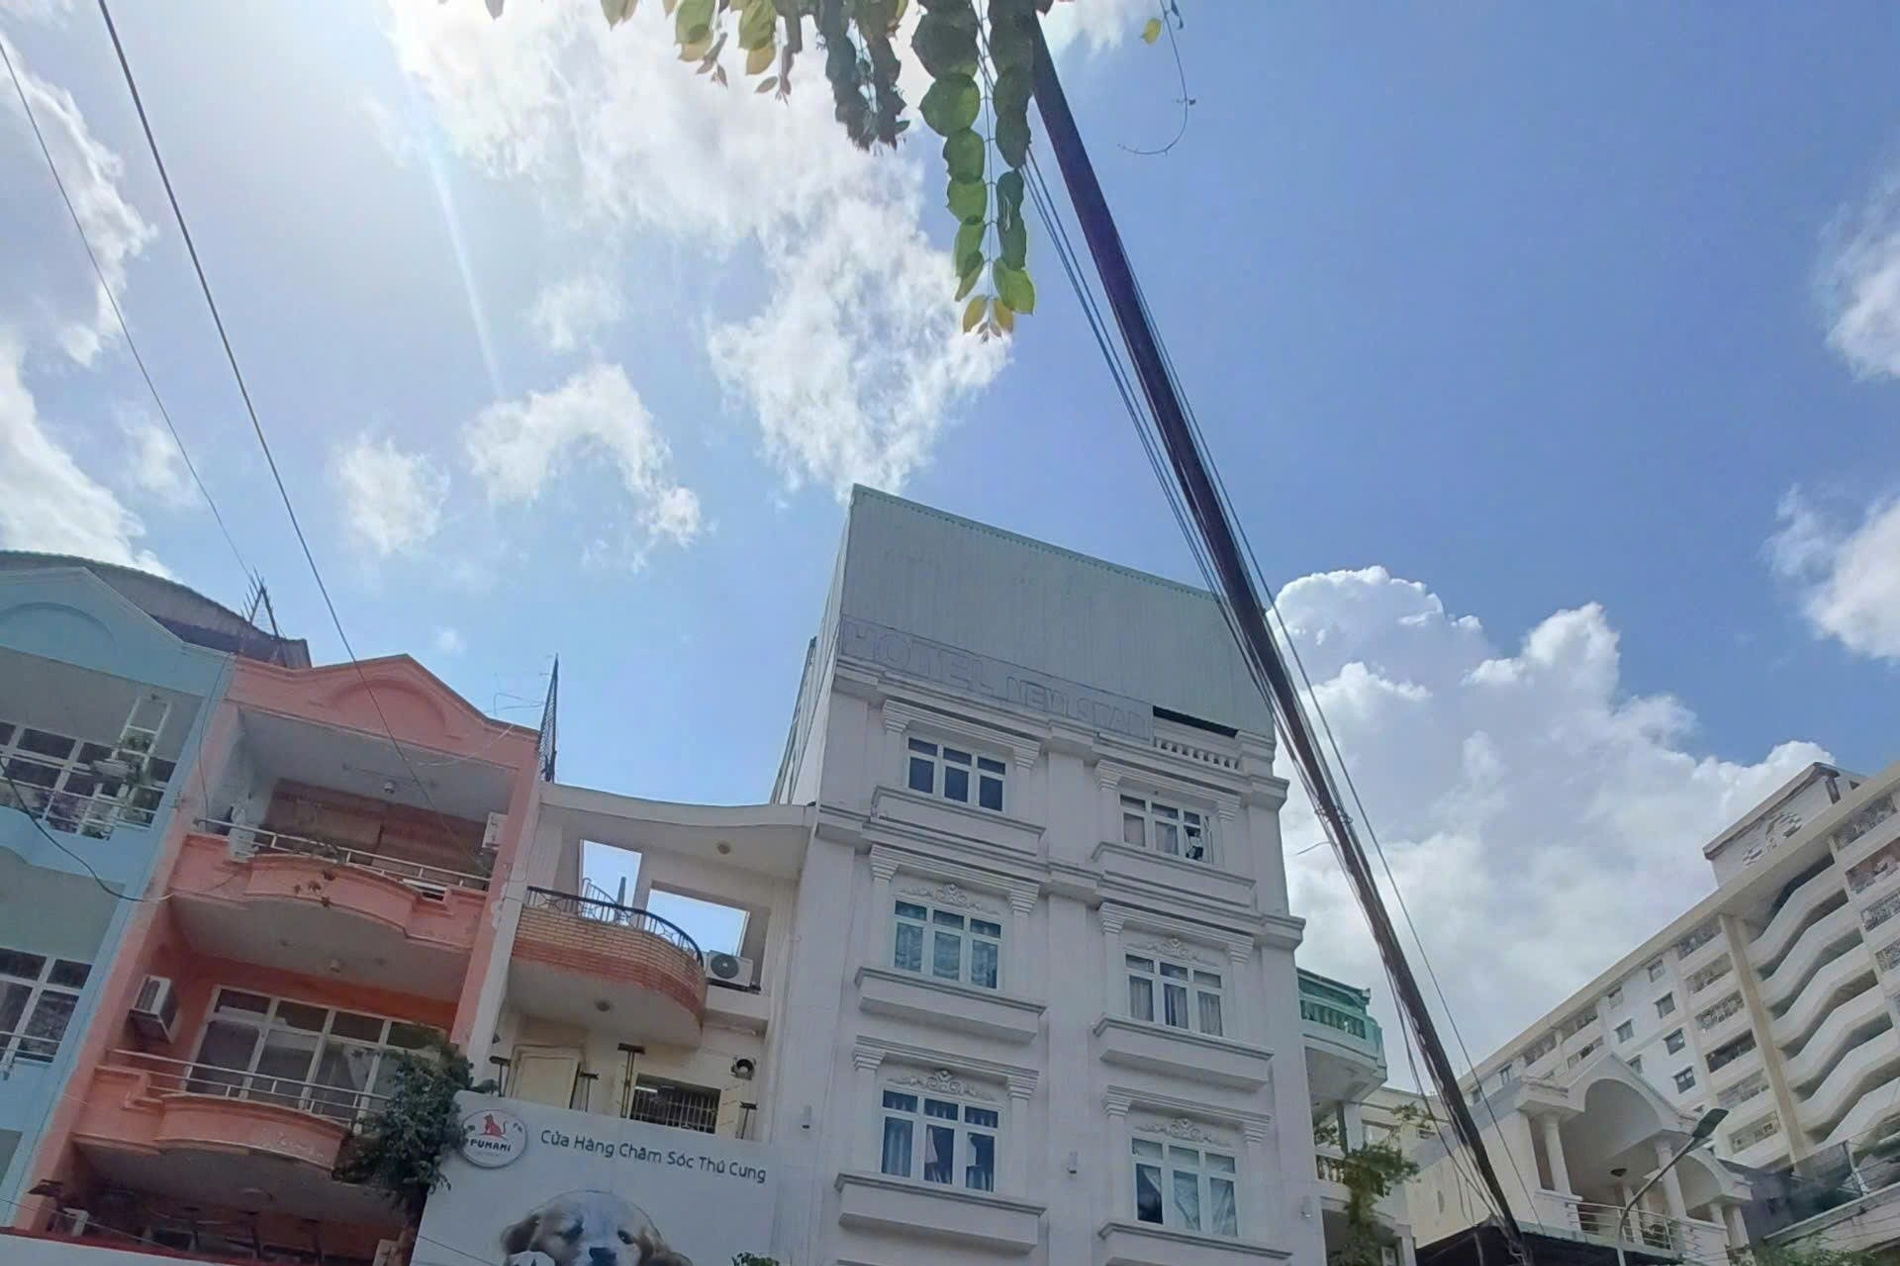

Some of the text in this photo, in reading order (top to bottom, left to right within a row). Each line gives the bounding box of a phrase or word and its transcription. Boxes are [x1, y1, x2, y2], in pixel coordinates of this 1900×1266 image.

[541, 1129, 570, 1148] Cửa
[573, 1135, 615, 1158] Hàng
[667, 1150, 694, 1169] Sóc
[698, 1155, 726, 1175] Thú
[729, 1161, 767, 1184] Cung
